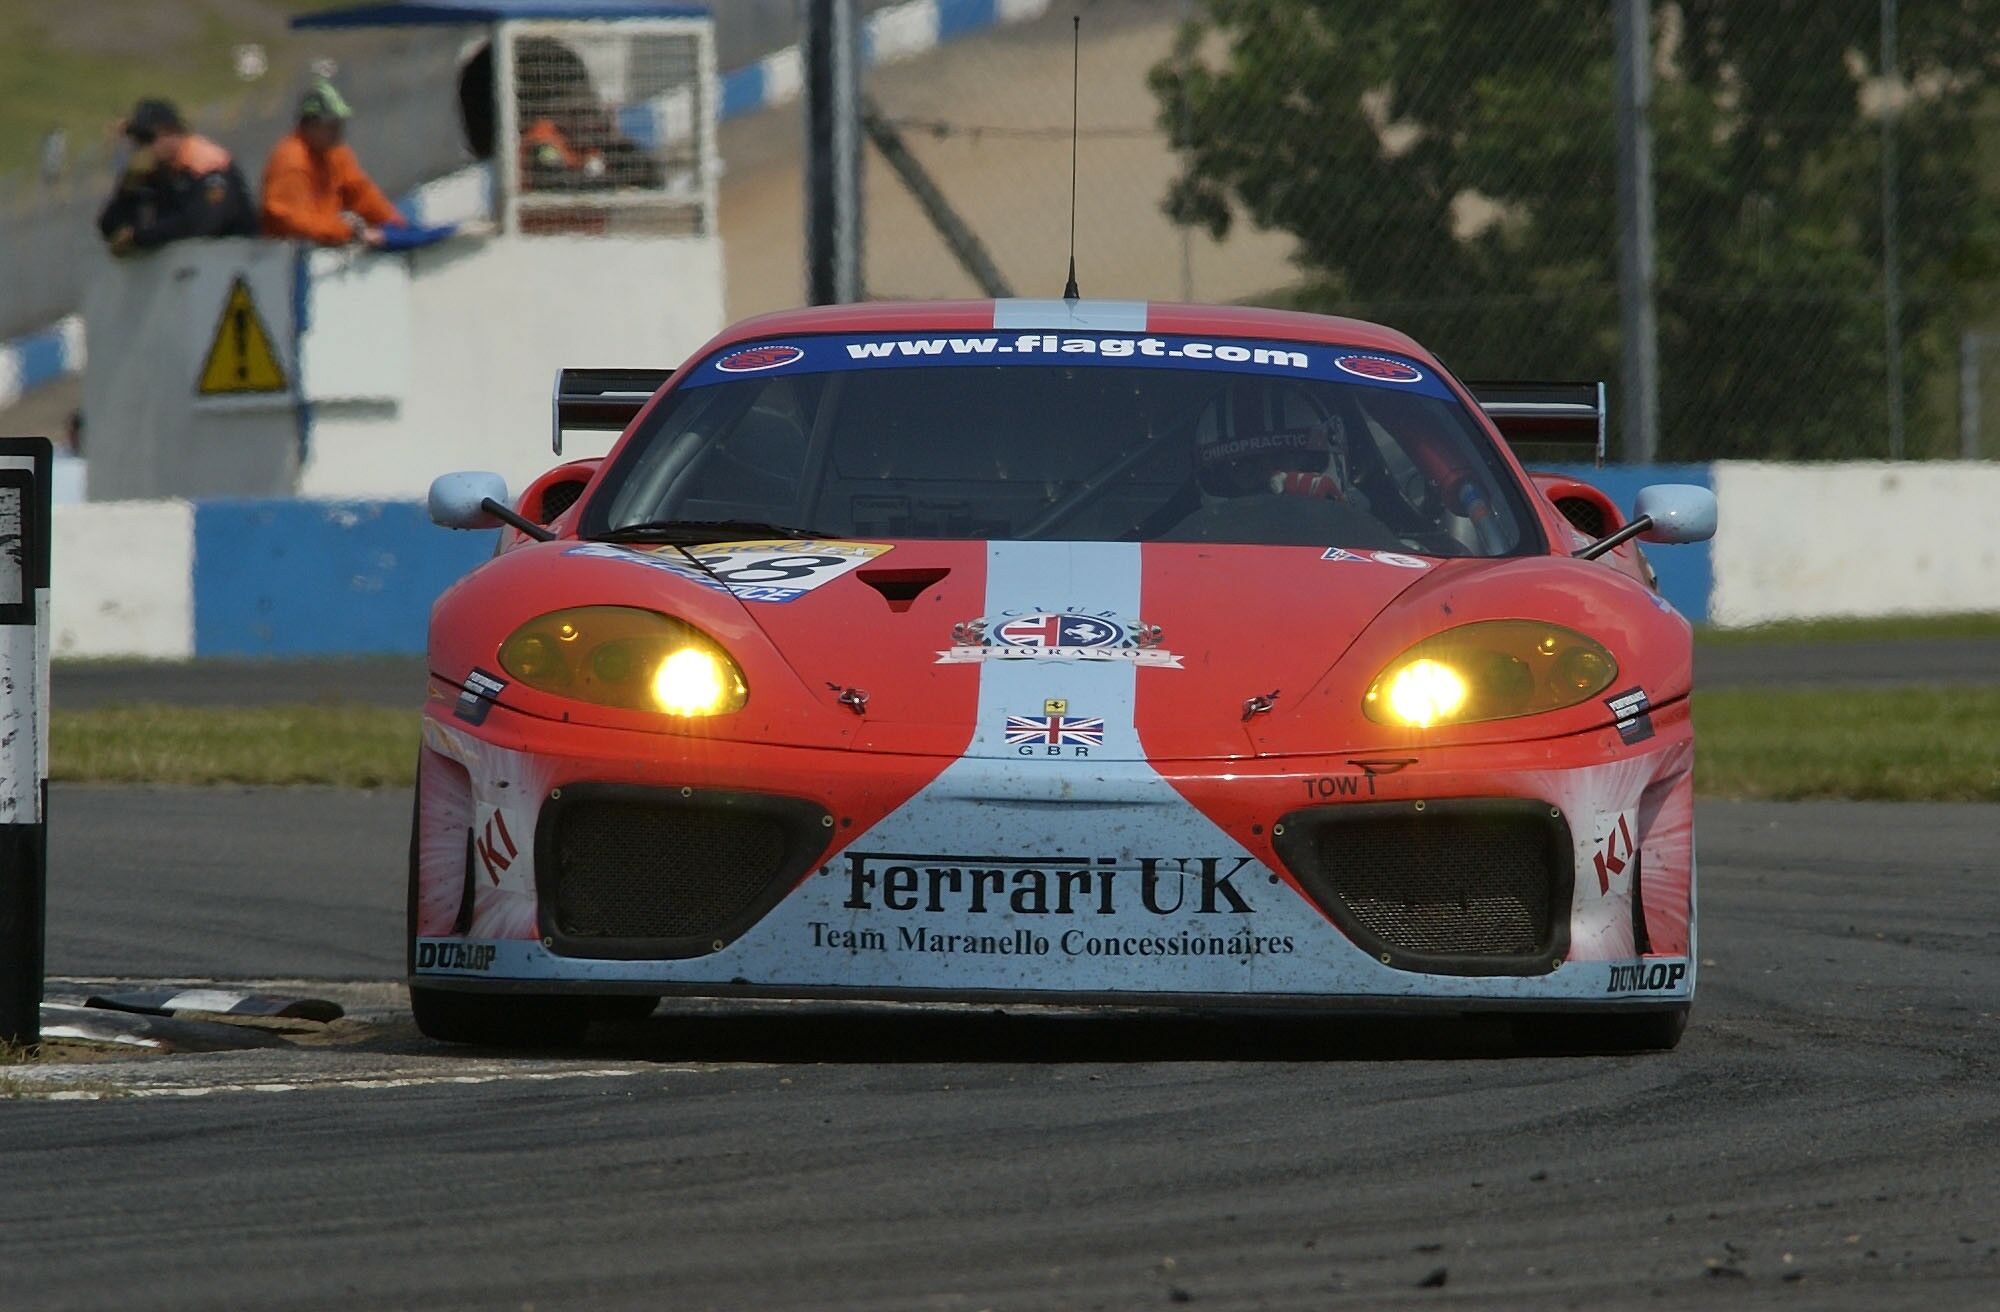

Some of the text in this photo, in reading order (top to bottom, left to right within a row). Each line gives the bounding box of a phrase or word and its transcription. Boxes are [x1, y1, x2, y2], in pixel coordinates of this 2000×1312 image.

[846, 335, 1309, 368] www.fiagt.com
[1002, 606, 1117, 617] CLUB
[1303, 771, 1357, 798] TOW
[843, 851, 1257, 915] Ferrari UK
[808, 921, 1294, 957] Team Maranello Concessionaires
[417, 942, 496, 971] DUNLOP
[1607, 963, 1685, 993] DUNLOP
